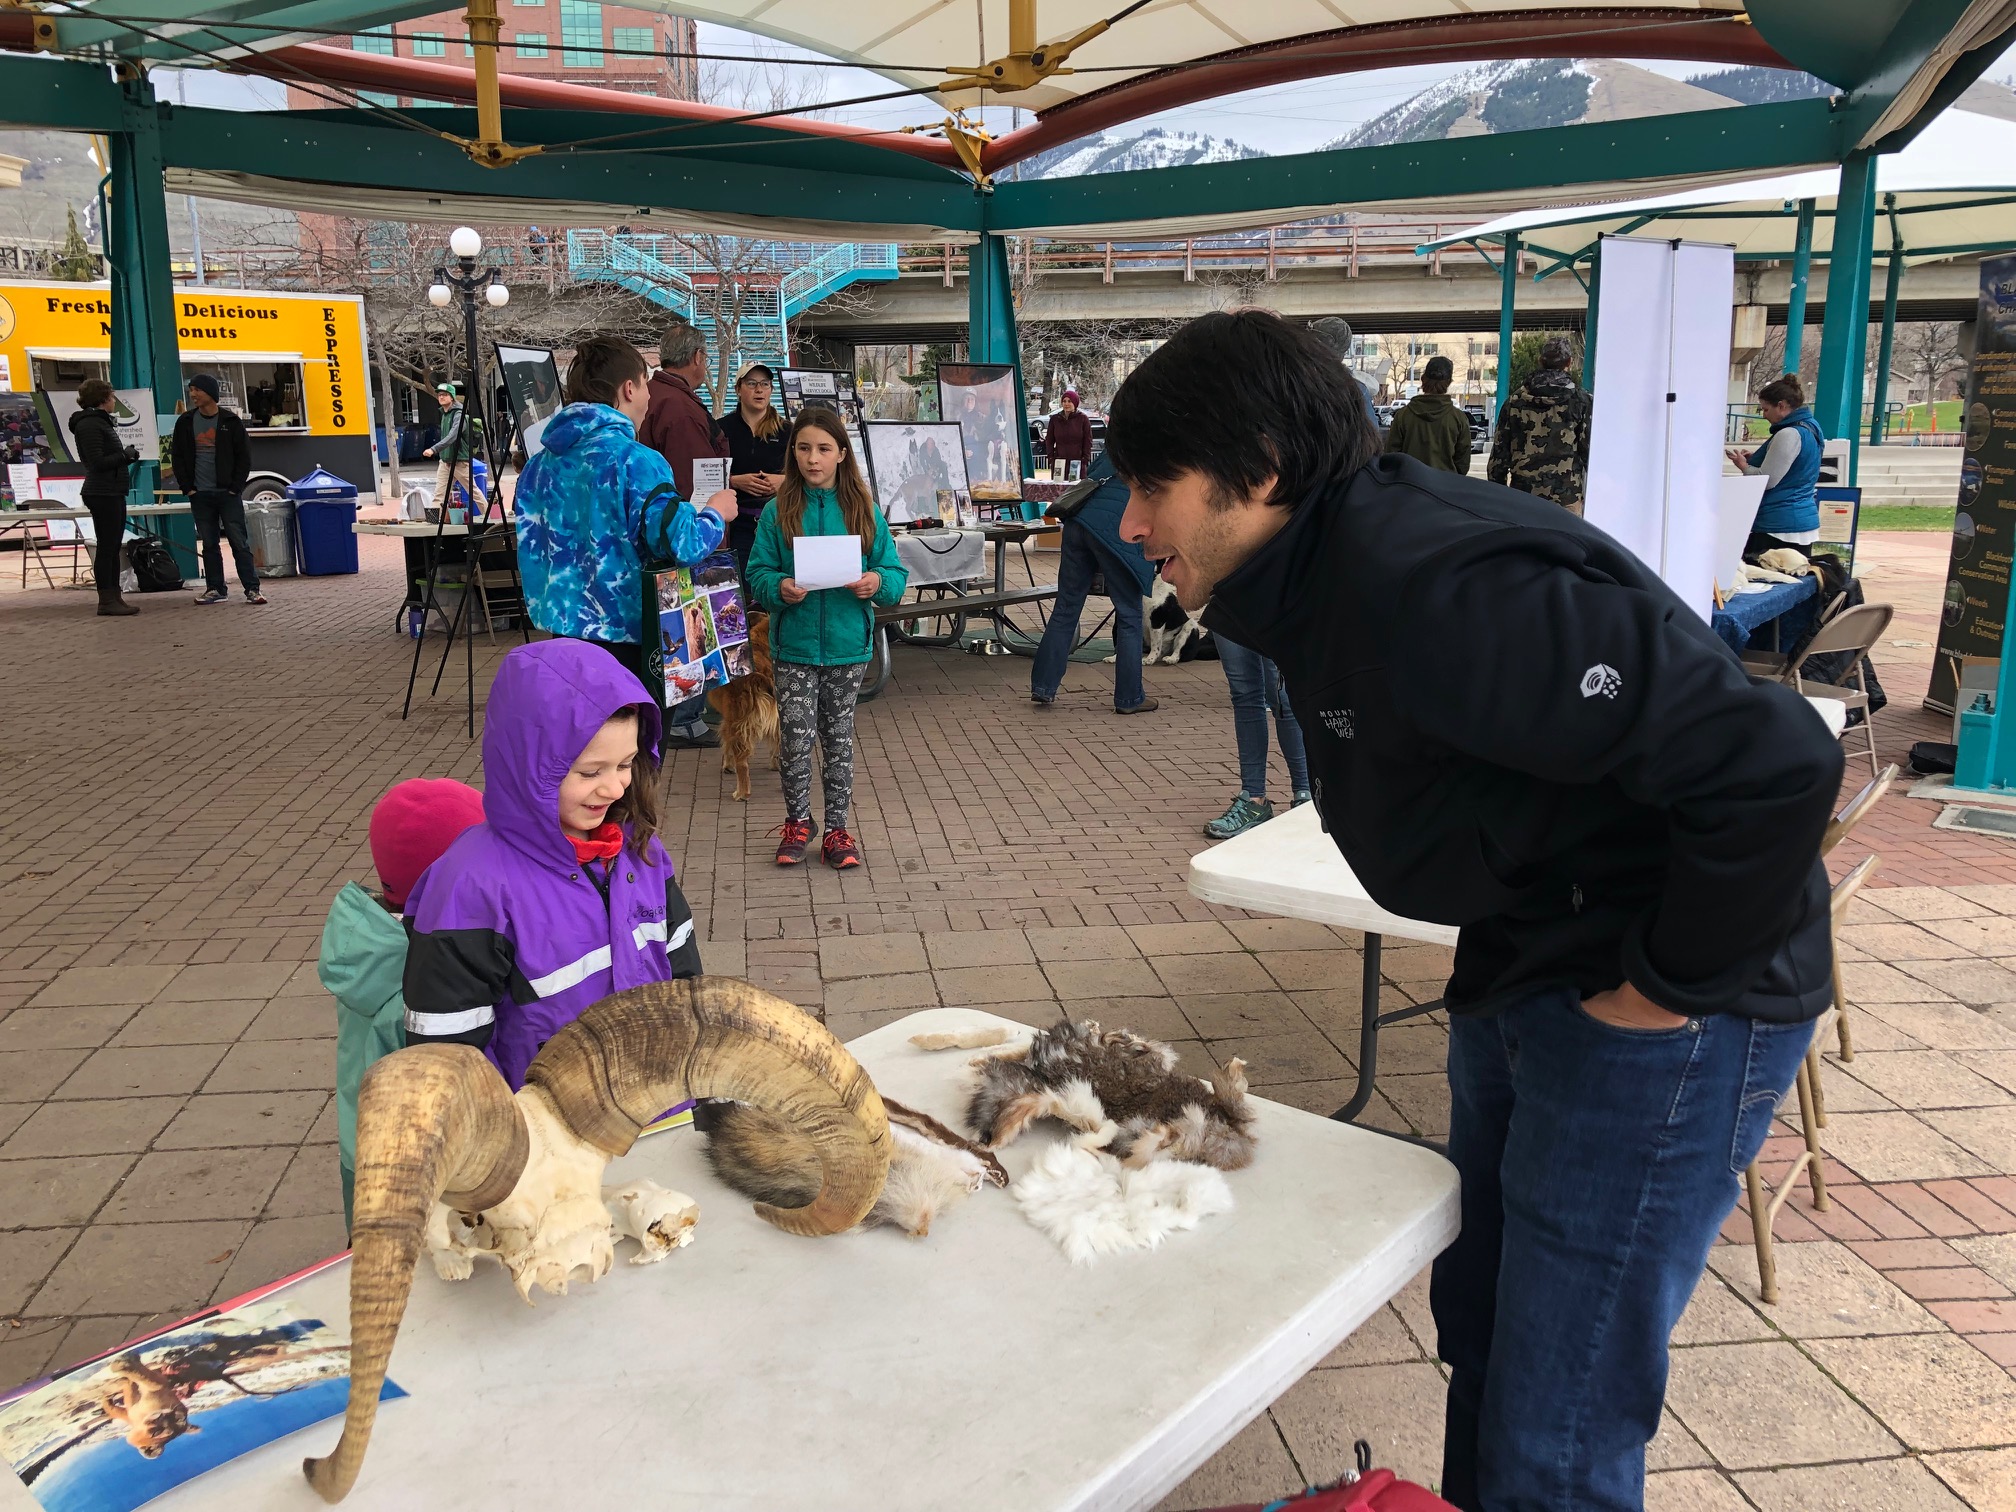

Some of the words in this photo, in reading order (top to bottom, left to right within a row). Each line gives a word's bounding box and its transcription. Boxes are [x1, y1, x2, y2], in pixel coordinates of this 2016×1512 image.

[46, 298, 111, 314] Fresh
[183, 303, 278, 320] Delicious
[178, 326, 237, 339] onuts
[322, 308, 346, 428] ESPRESSO
[1975, 616, 2003, 630] Education
[1324, 717, 1350, 729] HARD
